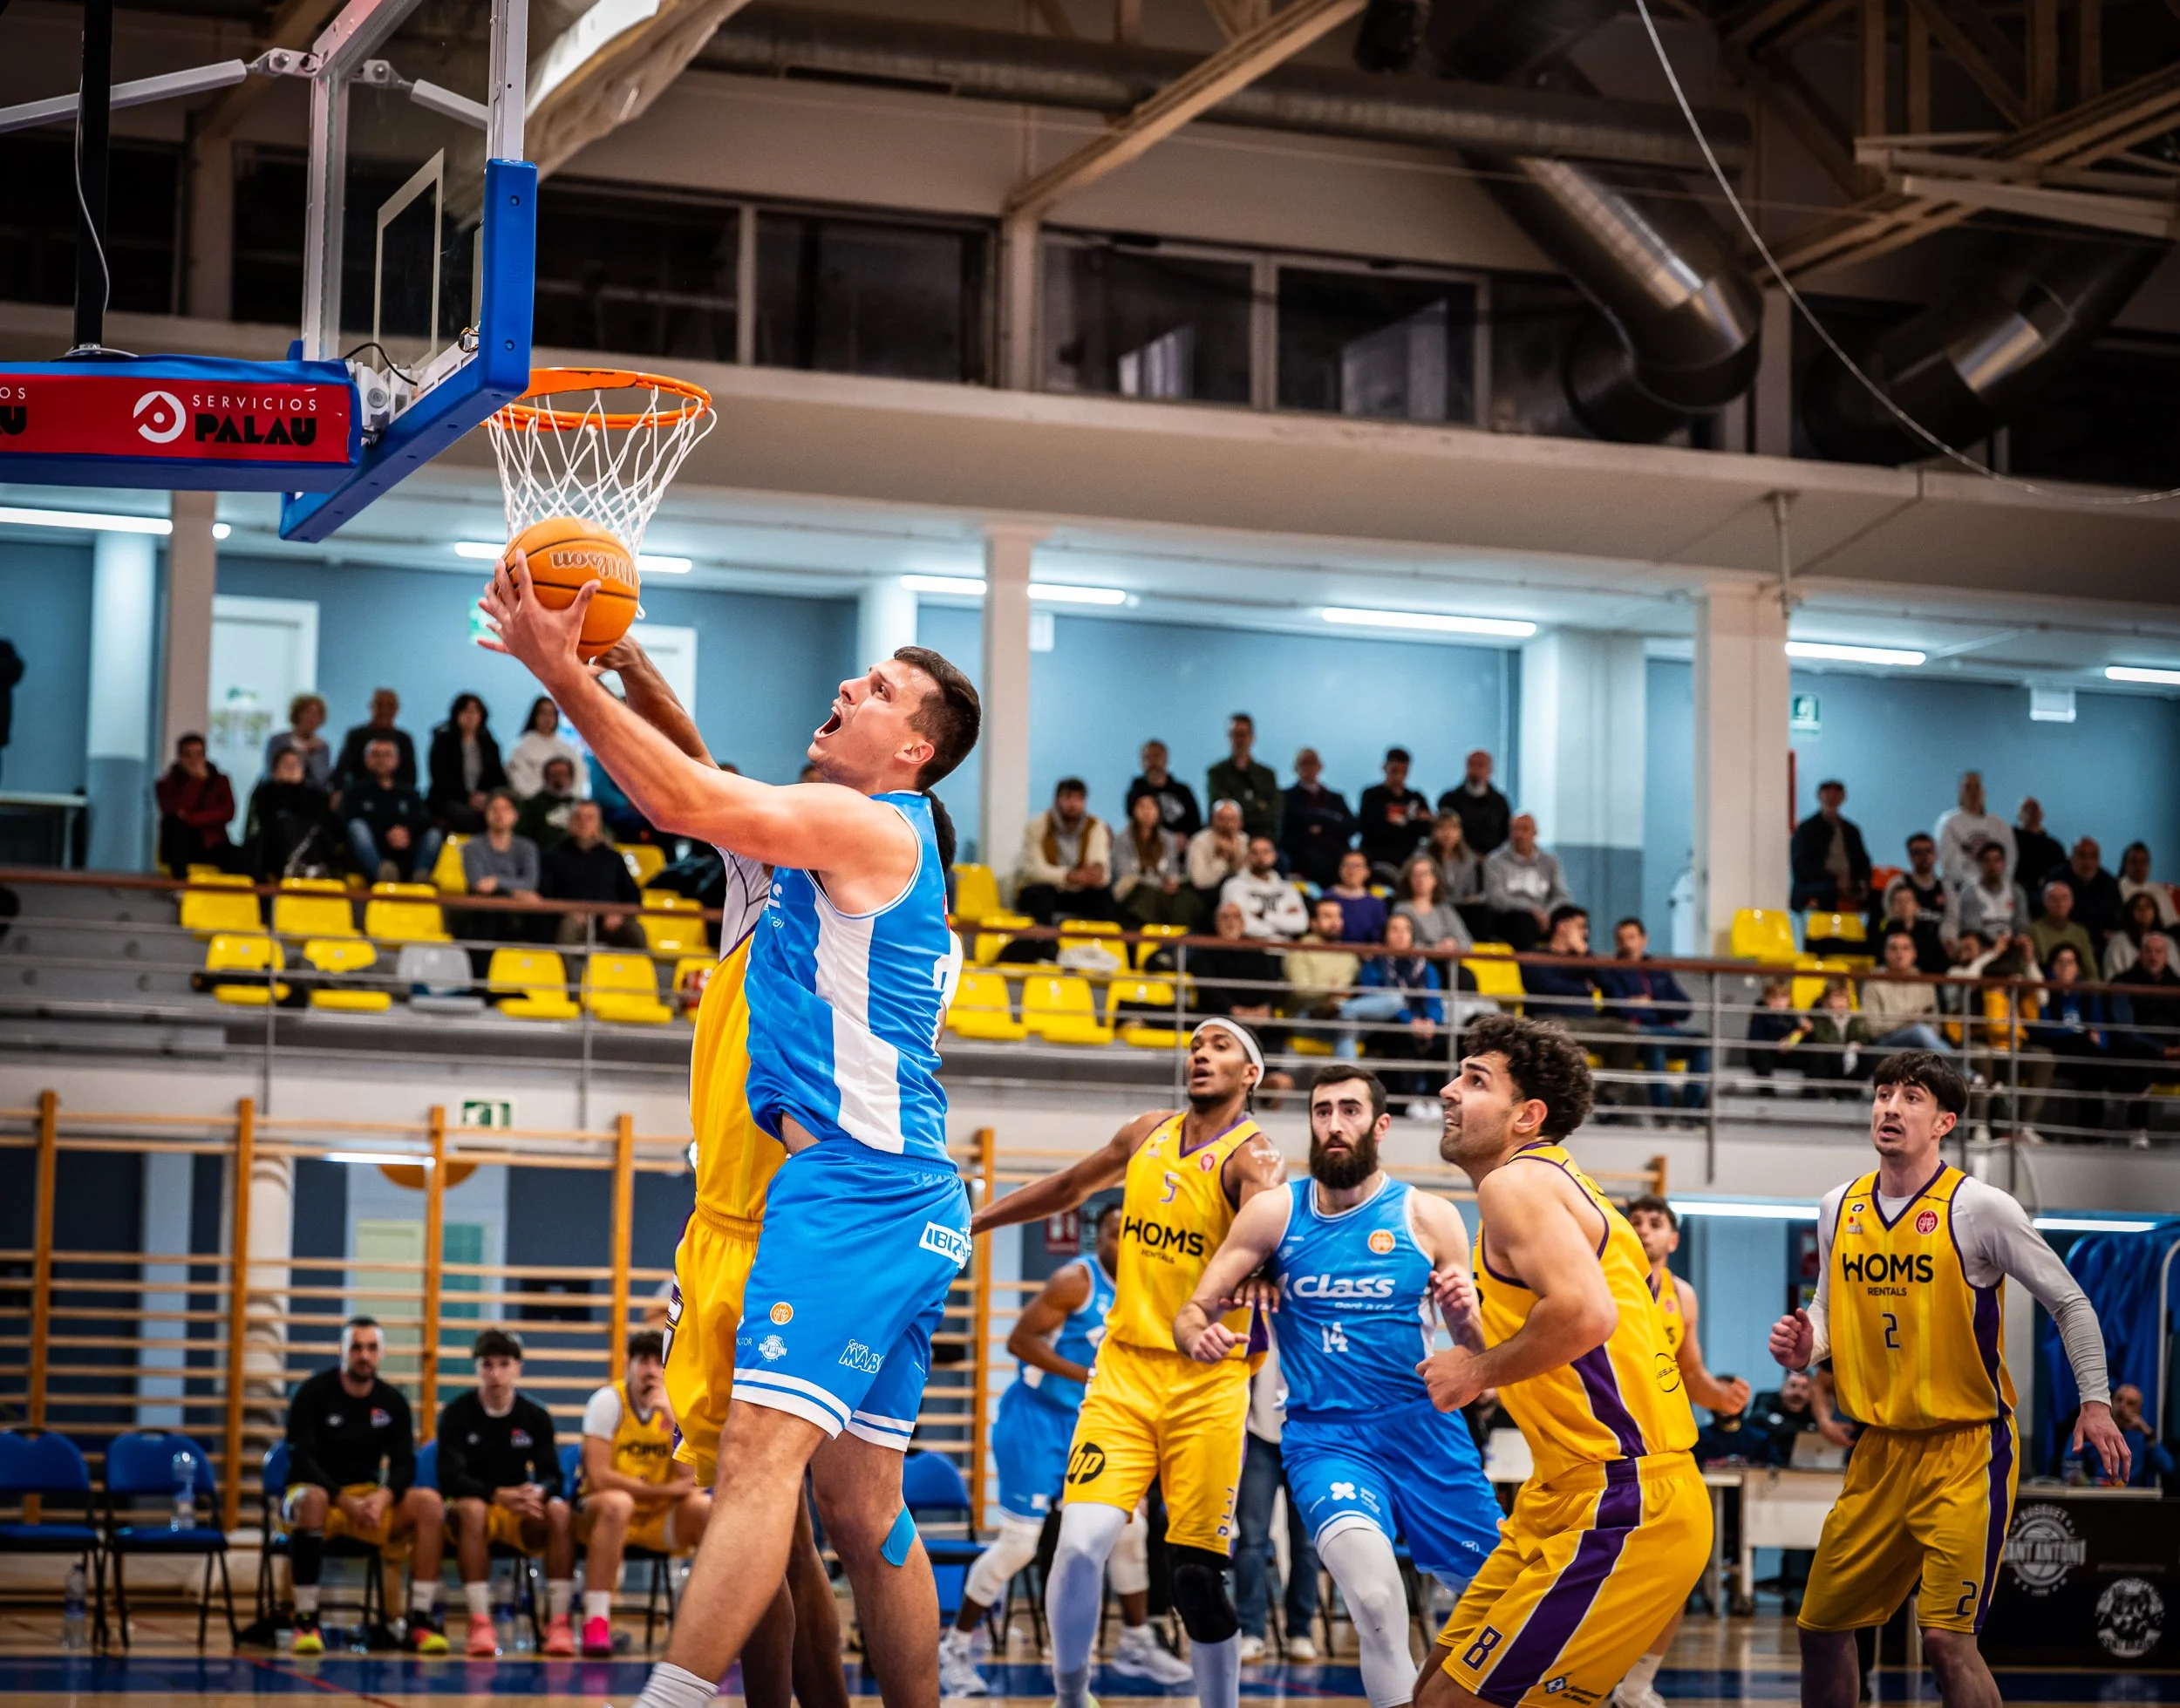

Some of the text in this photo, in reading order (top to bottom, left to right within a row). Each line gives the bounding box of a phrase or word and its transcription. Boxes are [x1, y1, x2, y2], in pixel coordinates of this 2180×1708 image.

[193, 394, 317, 411] SERVICIOS
[194, 413, 317, 446] PALAU
[1123, 1215, 1204, 1256] HOMS
[1843, 1253, 1933, 1283] HOMS
[1868, 1287, 1907, 1296] RENTALS
[1320, 1322, 1348, 1353] 14
[1882, 1313, 1900, 1349] 2
[1956, 1581, 1978, 1616] 2
[1461, 1624, 1504, 1671] 8
